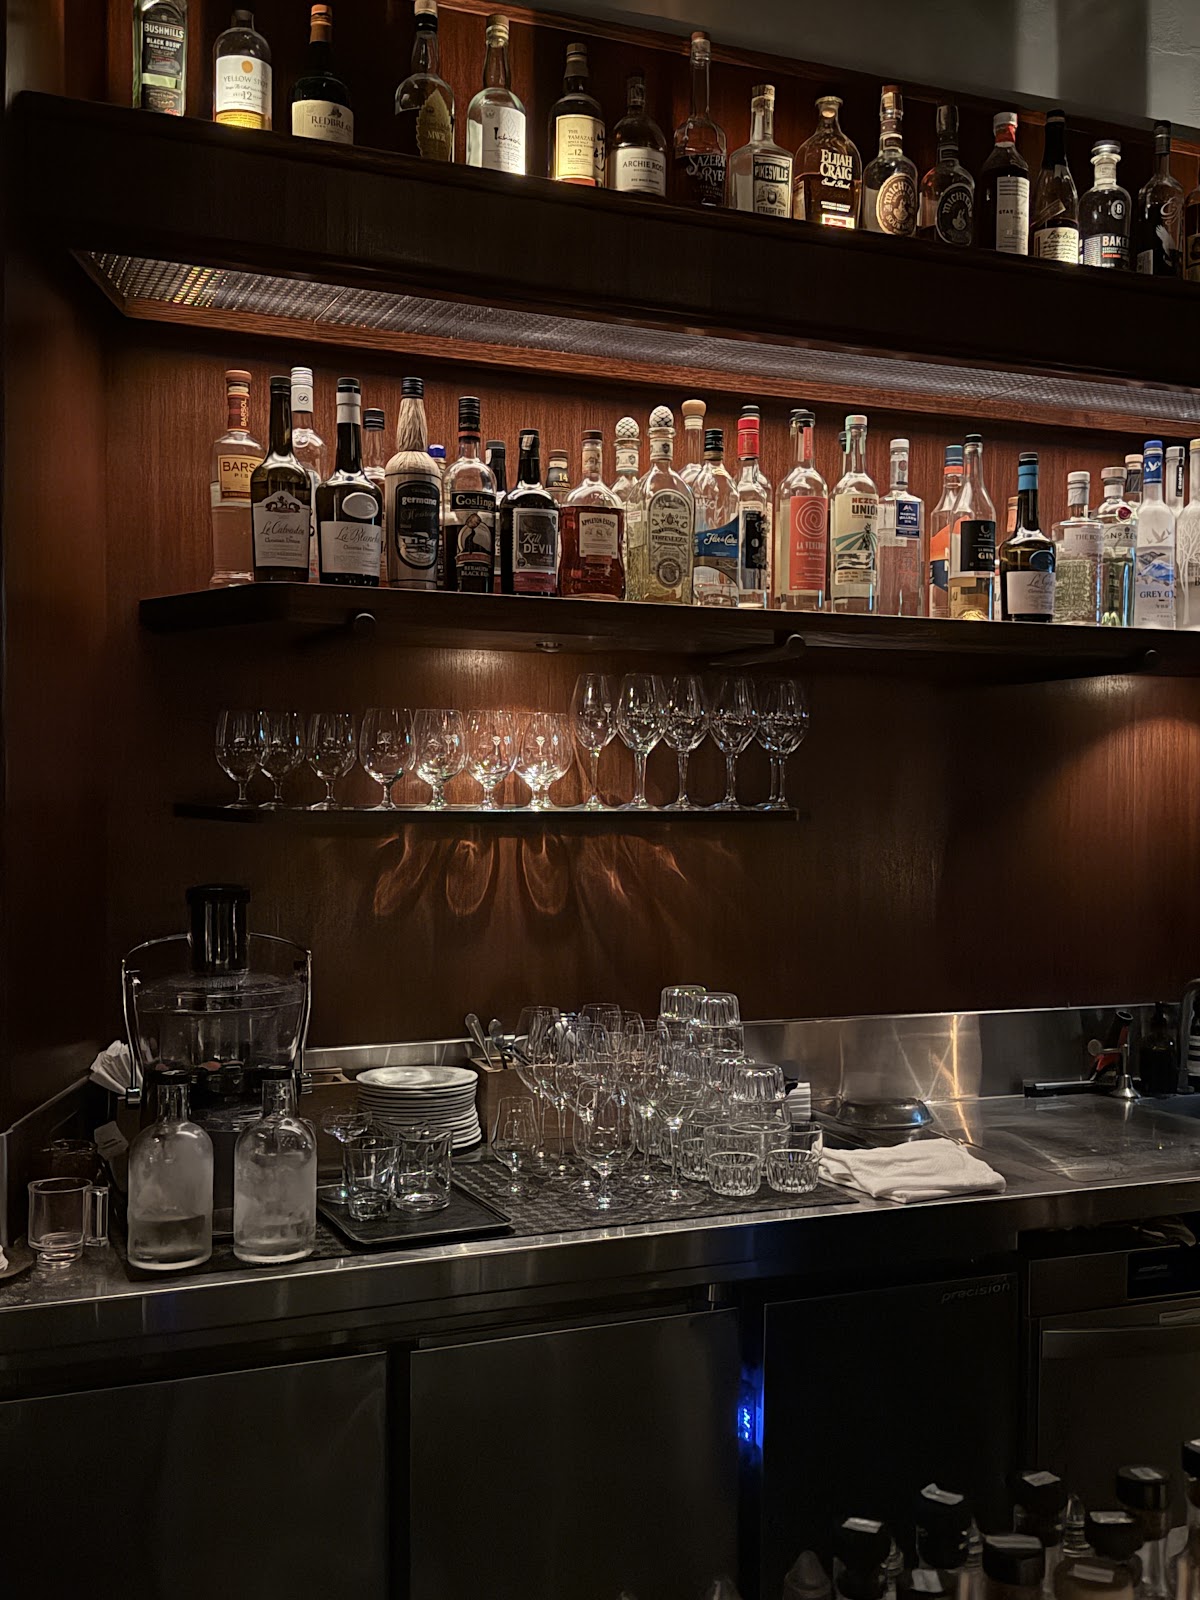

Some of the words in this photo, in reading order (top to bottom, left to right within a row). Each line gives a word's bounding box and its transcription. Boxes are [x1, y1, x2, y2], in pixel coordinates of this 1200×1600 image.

[144, 22, 185, 39] BUSHMILLS
[146, 37, 164, 46] BLACK
[223, 75, 252, 83] YELLOW
[253, 78, 268, 89] SPOT
[242, 91, 253, 100] 12
[567, 135, 596, 143] YAMAZAKI
[574, 149, 582, 157] 12
[820, 148, 853, 168] ELIJAH
[622, 160, 650, 169] ARCHIE
[754, 164, 789, 182] PIKESVILLE
[819, 162, 853, 181] CRAIG
[757, 206, 777, 215] STRAIGHT
[777, 208, 786, 217] RYE
[558, 472, 569, 482] 14
[401, 496, 438, 507] germana
[455, 494, 495, 511] Goslings
[581, 517, 602, 527] APPLETON
[260, 520, 271, 536] Le
[334, 526, 348, 543] La
[519, 532, 541, 544] Kill
[1075, 533, 1089, 541] THE
[523, 543, 554, 555] DEVIL
[796, 541, 804, 550] LA
[977, 551, 994, 560] GIN
[1139, 590, 1162, 599] GREY
[940, 1282, 1011, 1305] precision
